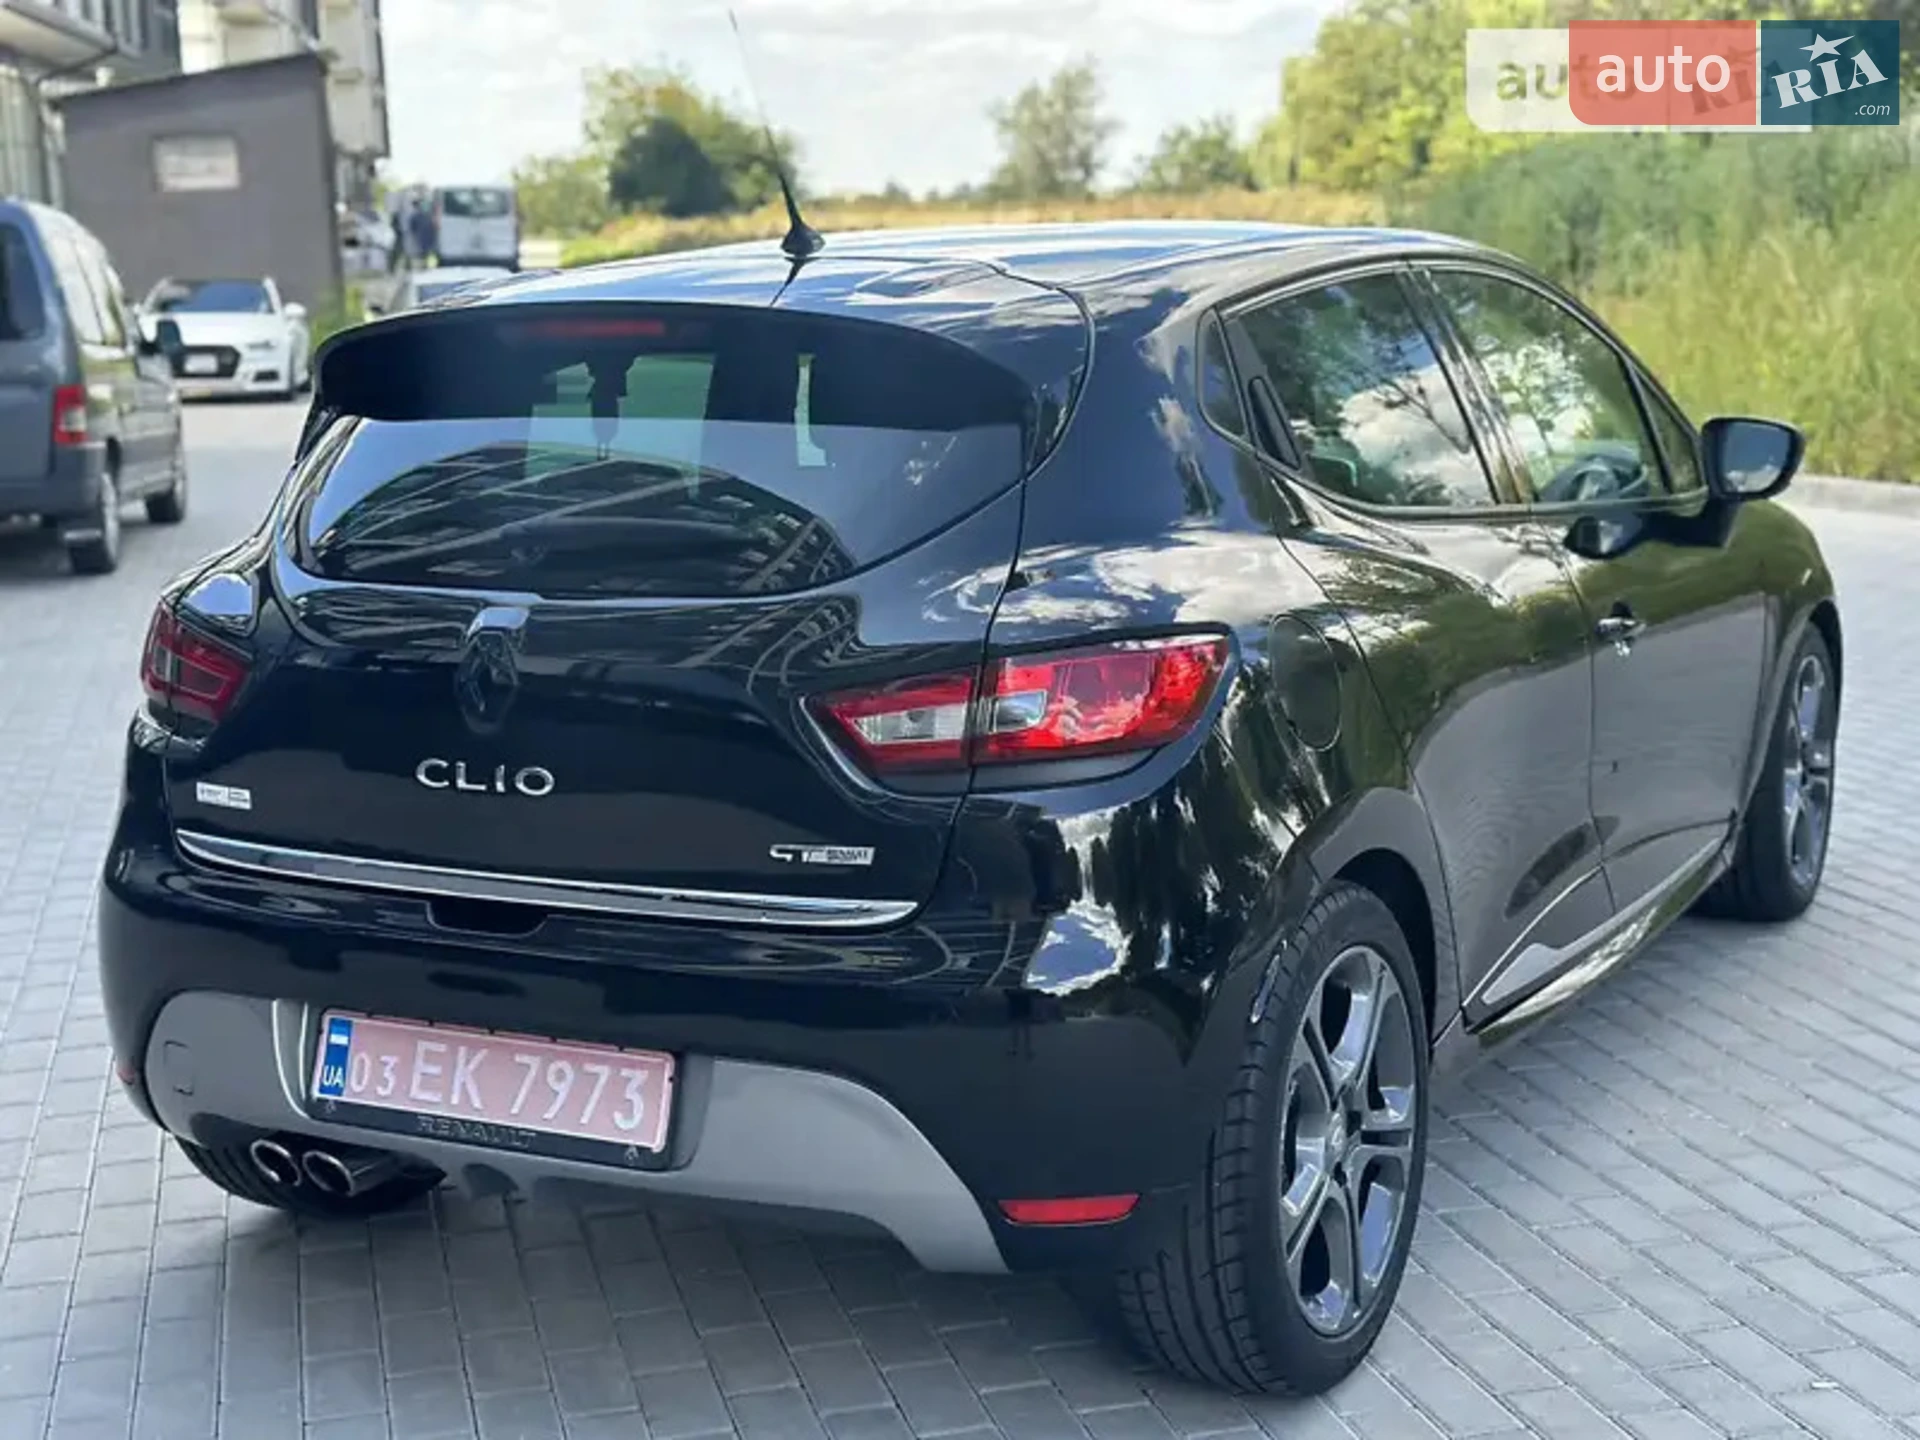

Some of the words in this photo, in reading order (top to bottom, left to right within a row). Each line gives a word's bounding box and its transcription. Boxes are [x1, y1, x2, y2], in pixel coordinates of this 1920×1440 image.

[415, 758, 555, 796] CLIO
[322, 1065, 344, 1087] UA
[510, 1053, 648, 1130] 7973
[416, 1105, 537, 1148] RENAULT
